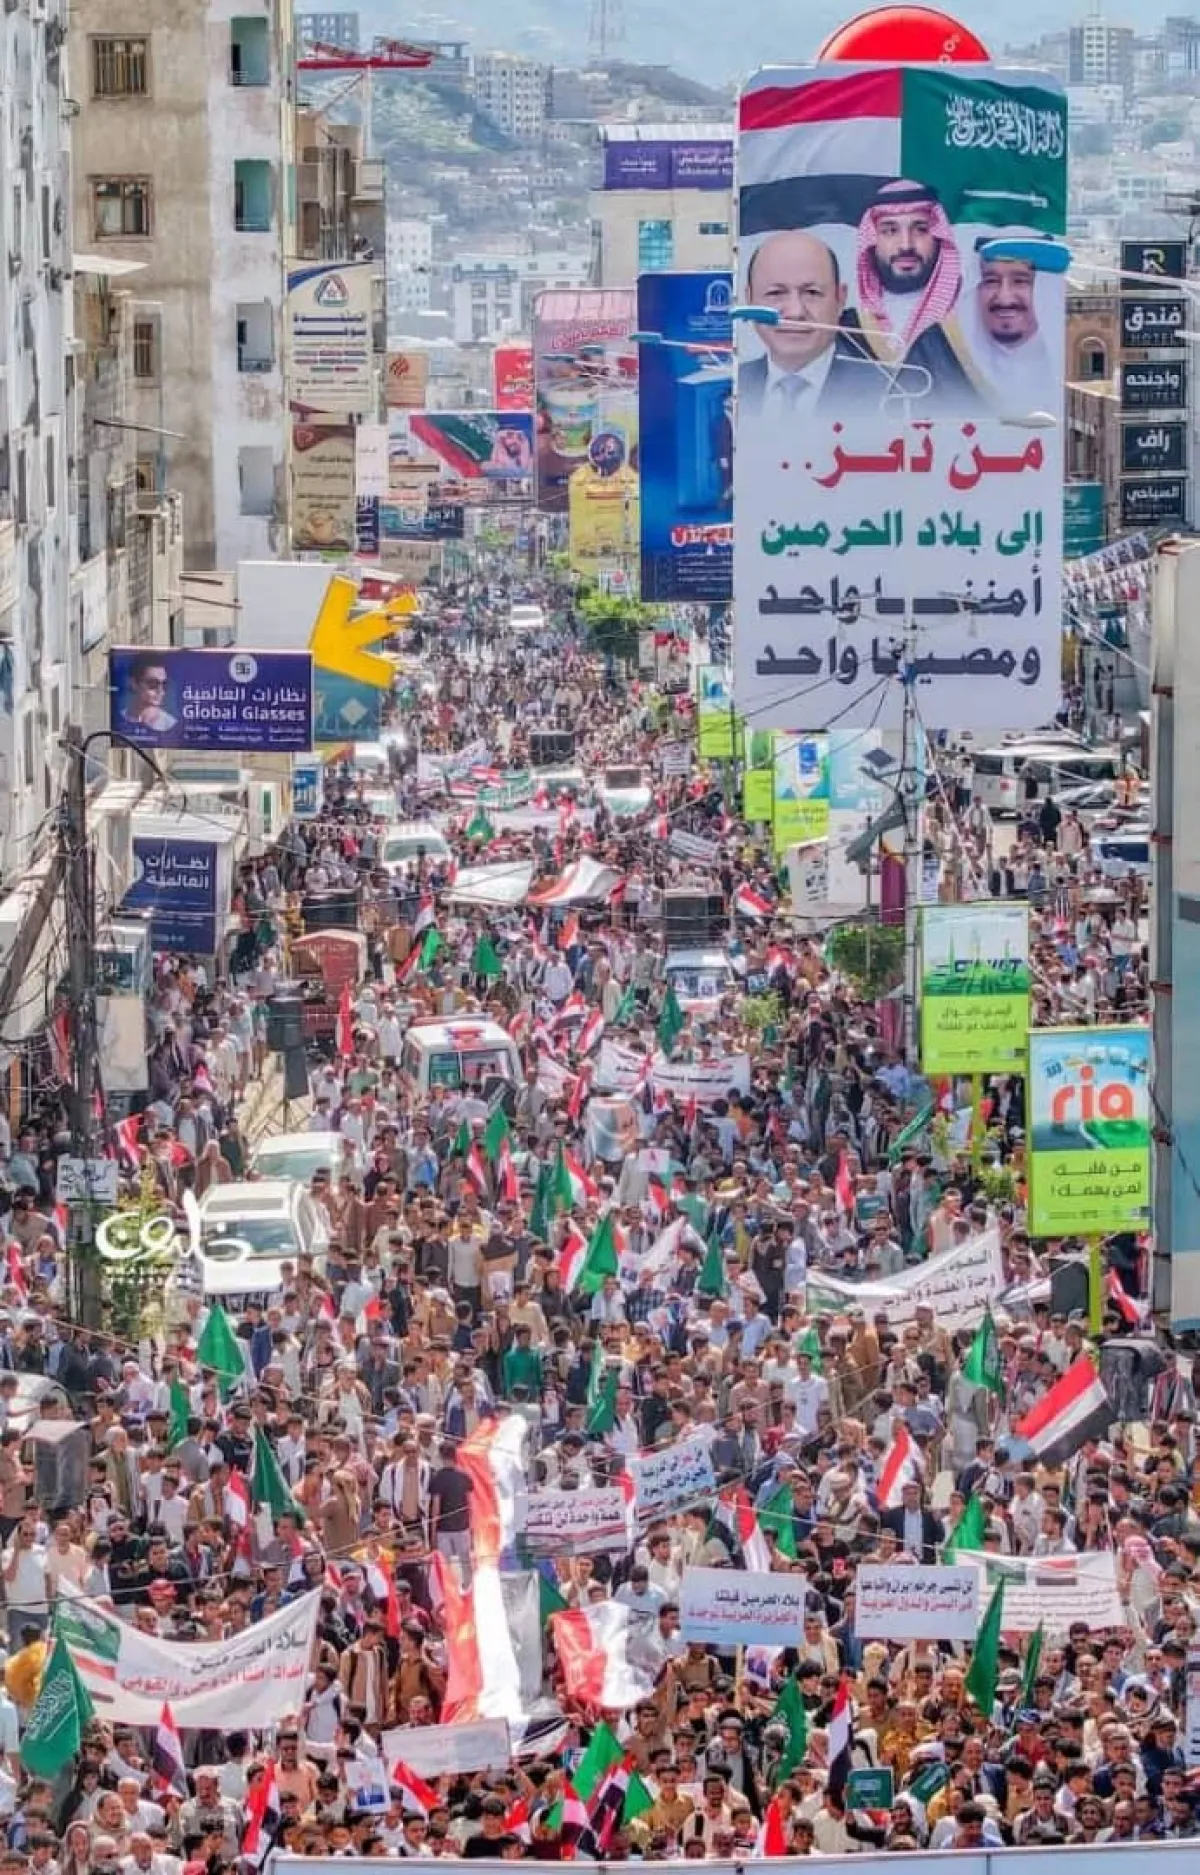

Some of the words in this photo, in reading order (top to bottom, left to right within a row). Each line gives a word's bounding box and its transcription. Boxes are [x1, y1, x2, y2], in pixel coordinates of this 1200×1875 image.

[1125, 306, 1181, 331] فندق
[948, 422, 1043, 489] من
[1136, 429, 1170, 452] راف
[761, 509, 903, 556] الحرمين
[917, 510, 981, 554] بلاد
[996, 510, 1043, 557] إلى
[758, 574, 859, 624] واحد
[756, 637, 858, 685] واحد
[871, 637, 1041, 685] ومصينا
[182, 685, 246, 704] العالمية
[182, 704, 237, 720] Global
[242, 706, 306, 721] Glasses
[252, 684, 307, 706] نظارات
[1053, 1065, 1135, 1122] ria
[1110, 1163, 1142, 1177] من
